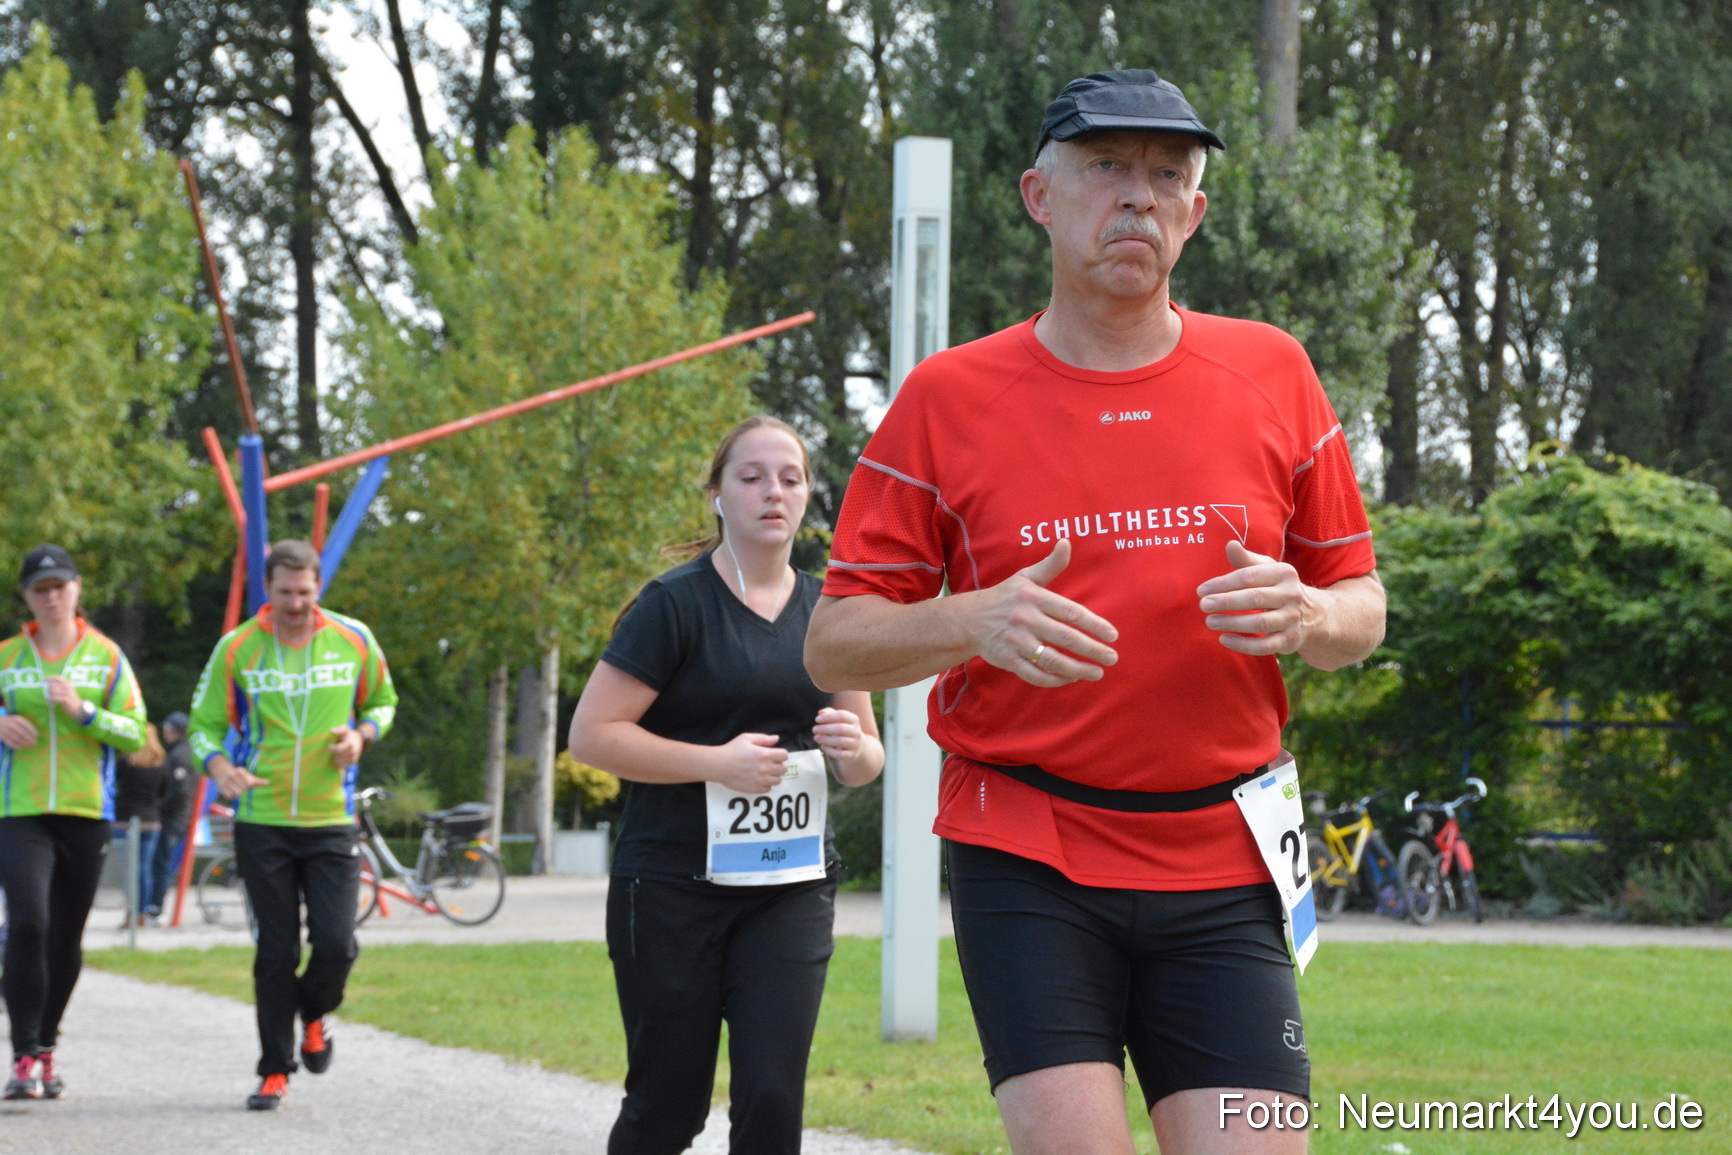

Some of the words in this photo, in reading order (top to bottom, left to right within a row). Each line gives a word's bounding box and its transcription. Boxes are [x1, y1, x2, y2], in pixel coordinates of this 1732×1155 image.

[1117, 410, 1152, 422] JAKO
[1020, 505, 1207, 547] SCHULTHEISS
[1114, 535, 1180, 550] Wohnbau
[1187, 532, 1205, 544] AG
[728, 792, 810, 835] 2360
[761, 848, 787, 863] Anja
[1280, 822, 1312, 890] 2
